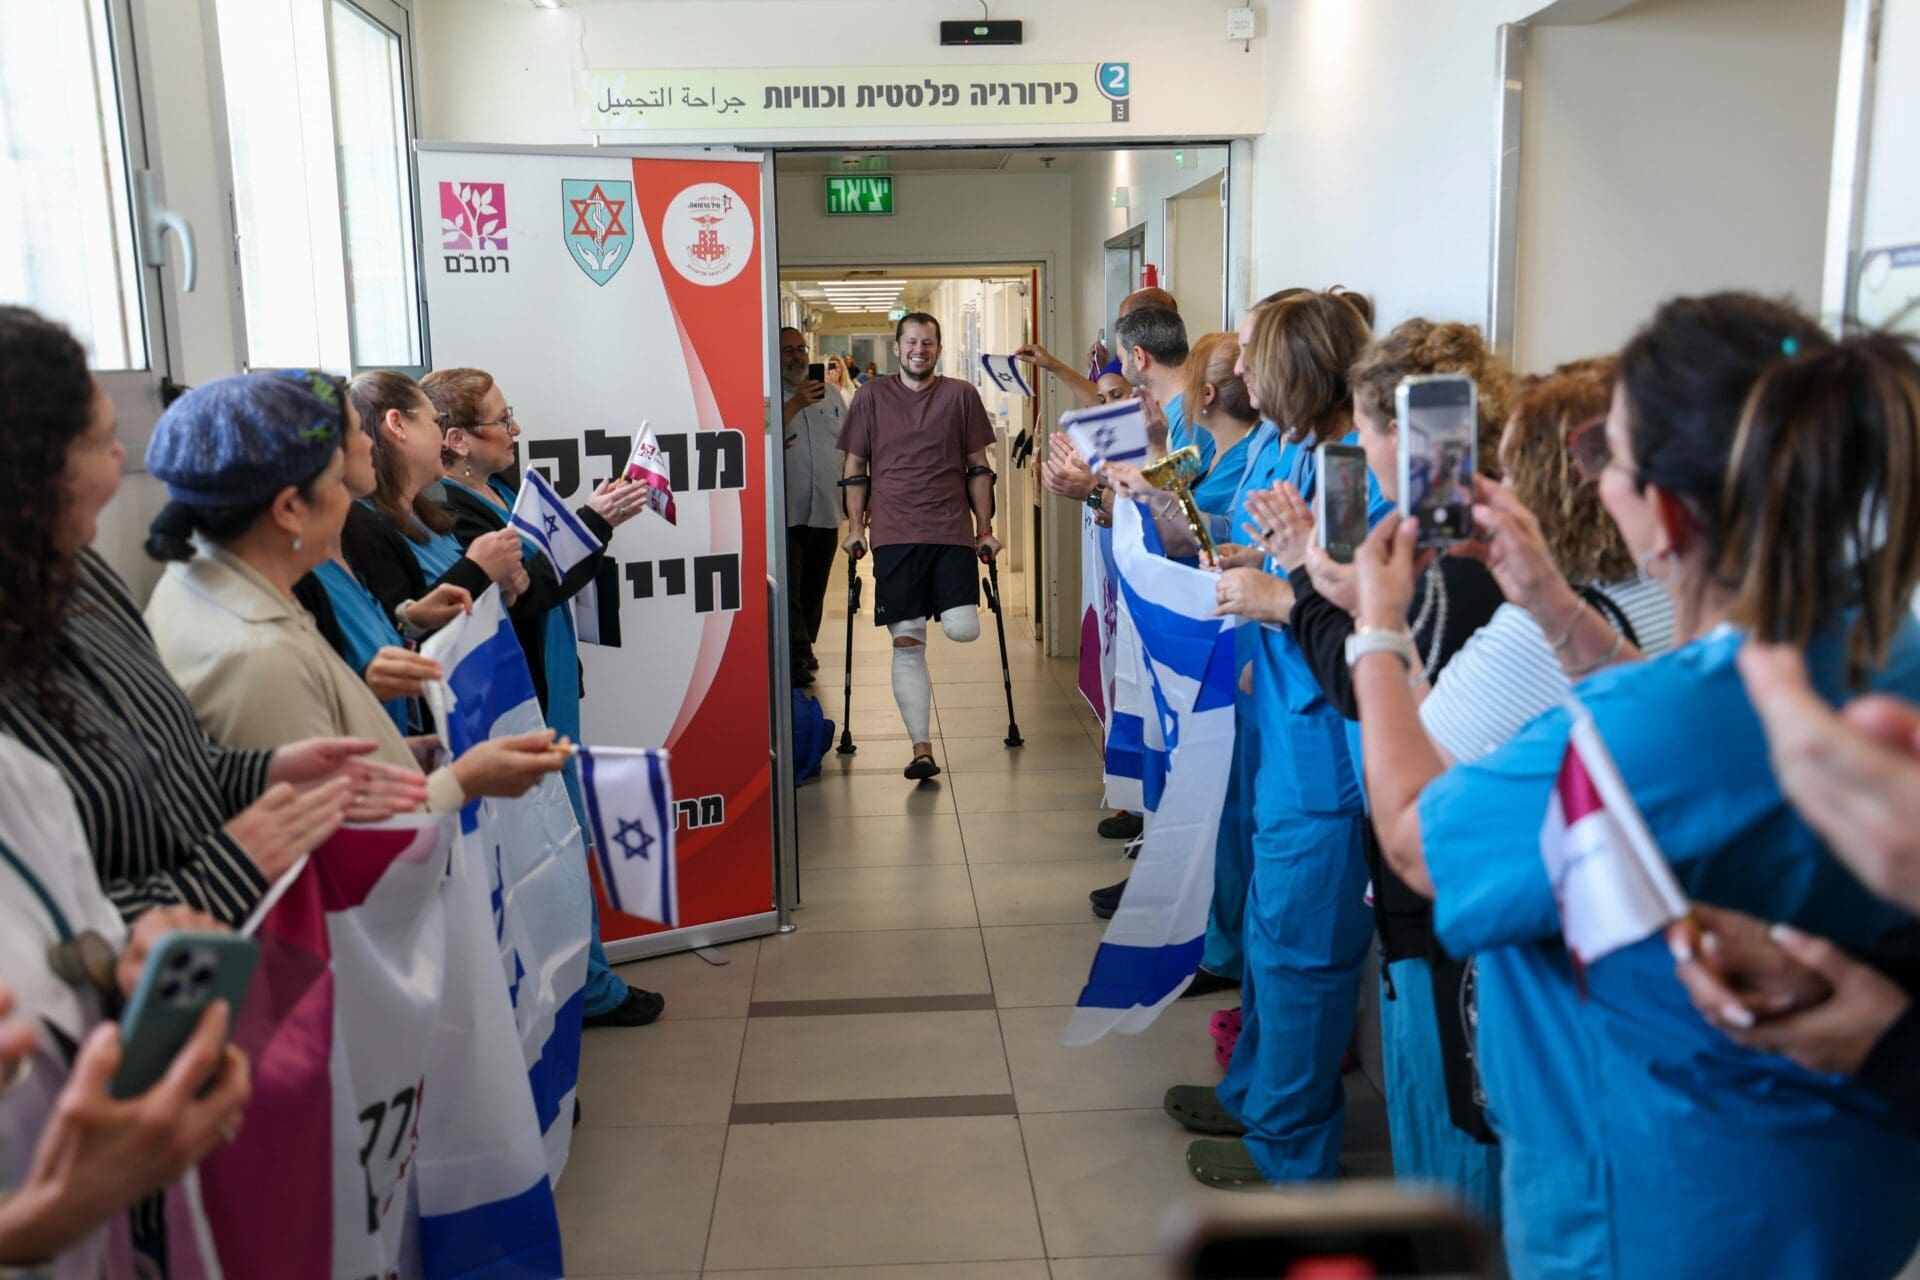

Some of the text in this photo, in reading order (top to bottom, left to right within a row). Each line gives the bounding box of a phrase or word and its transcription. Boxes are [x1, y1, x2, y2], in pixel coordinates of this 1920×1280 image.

[1108, 66, 1125, 89] 2
[597, 86, 746, 116] جراحة التجميل
[763, 79, 1079, 109] כירורגיה פלסטית וכוויות
[831, 179, 889, 212] יציאה
[606, 552, 741, 613] חיי
[671, 795, 723, 831] מר
